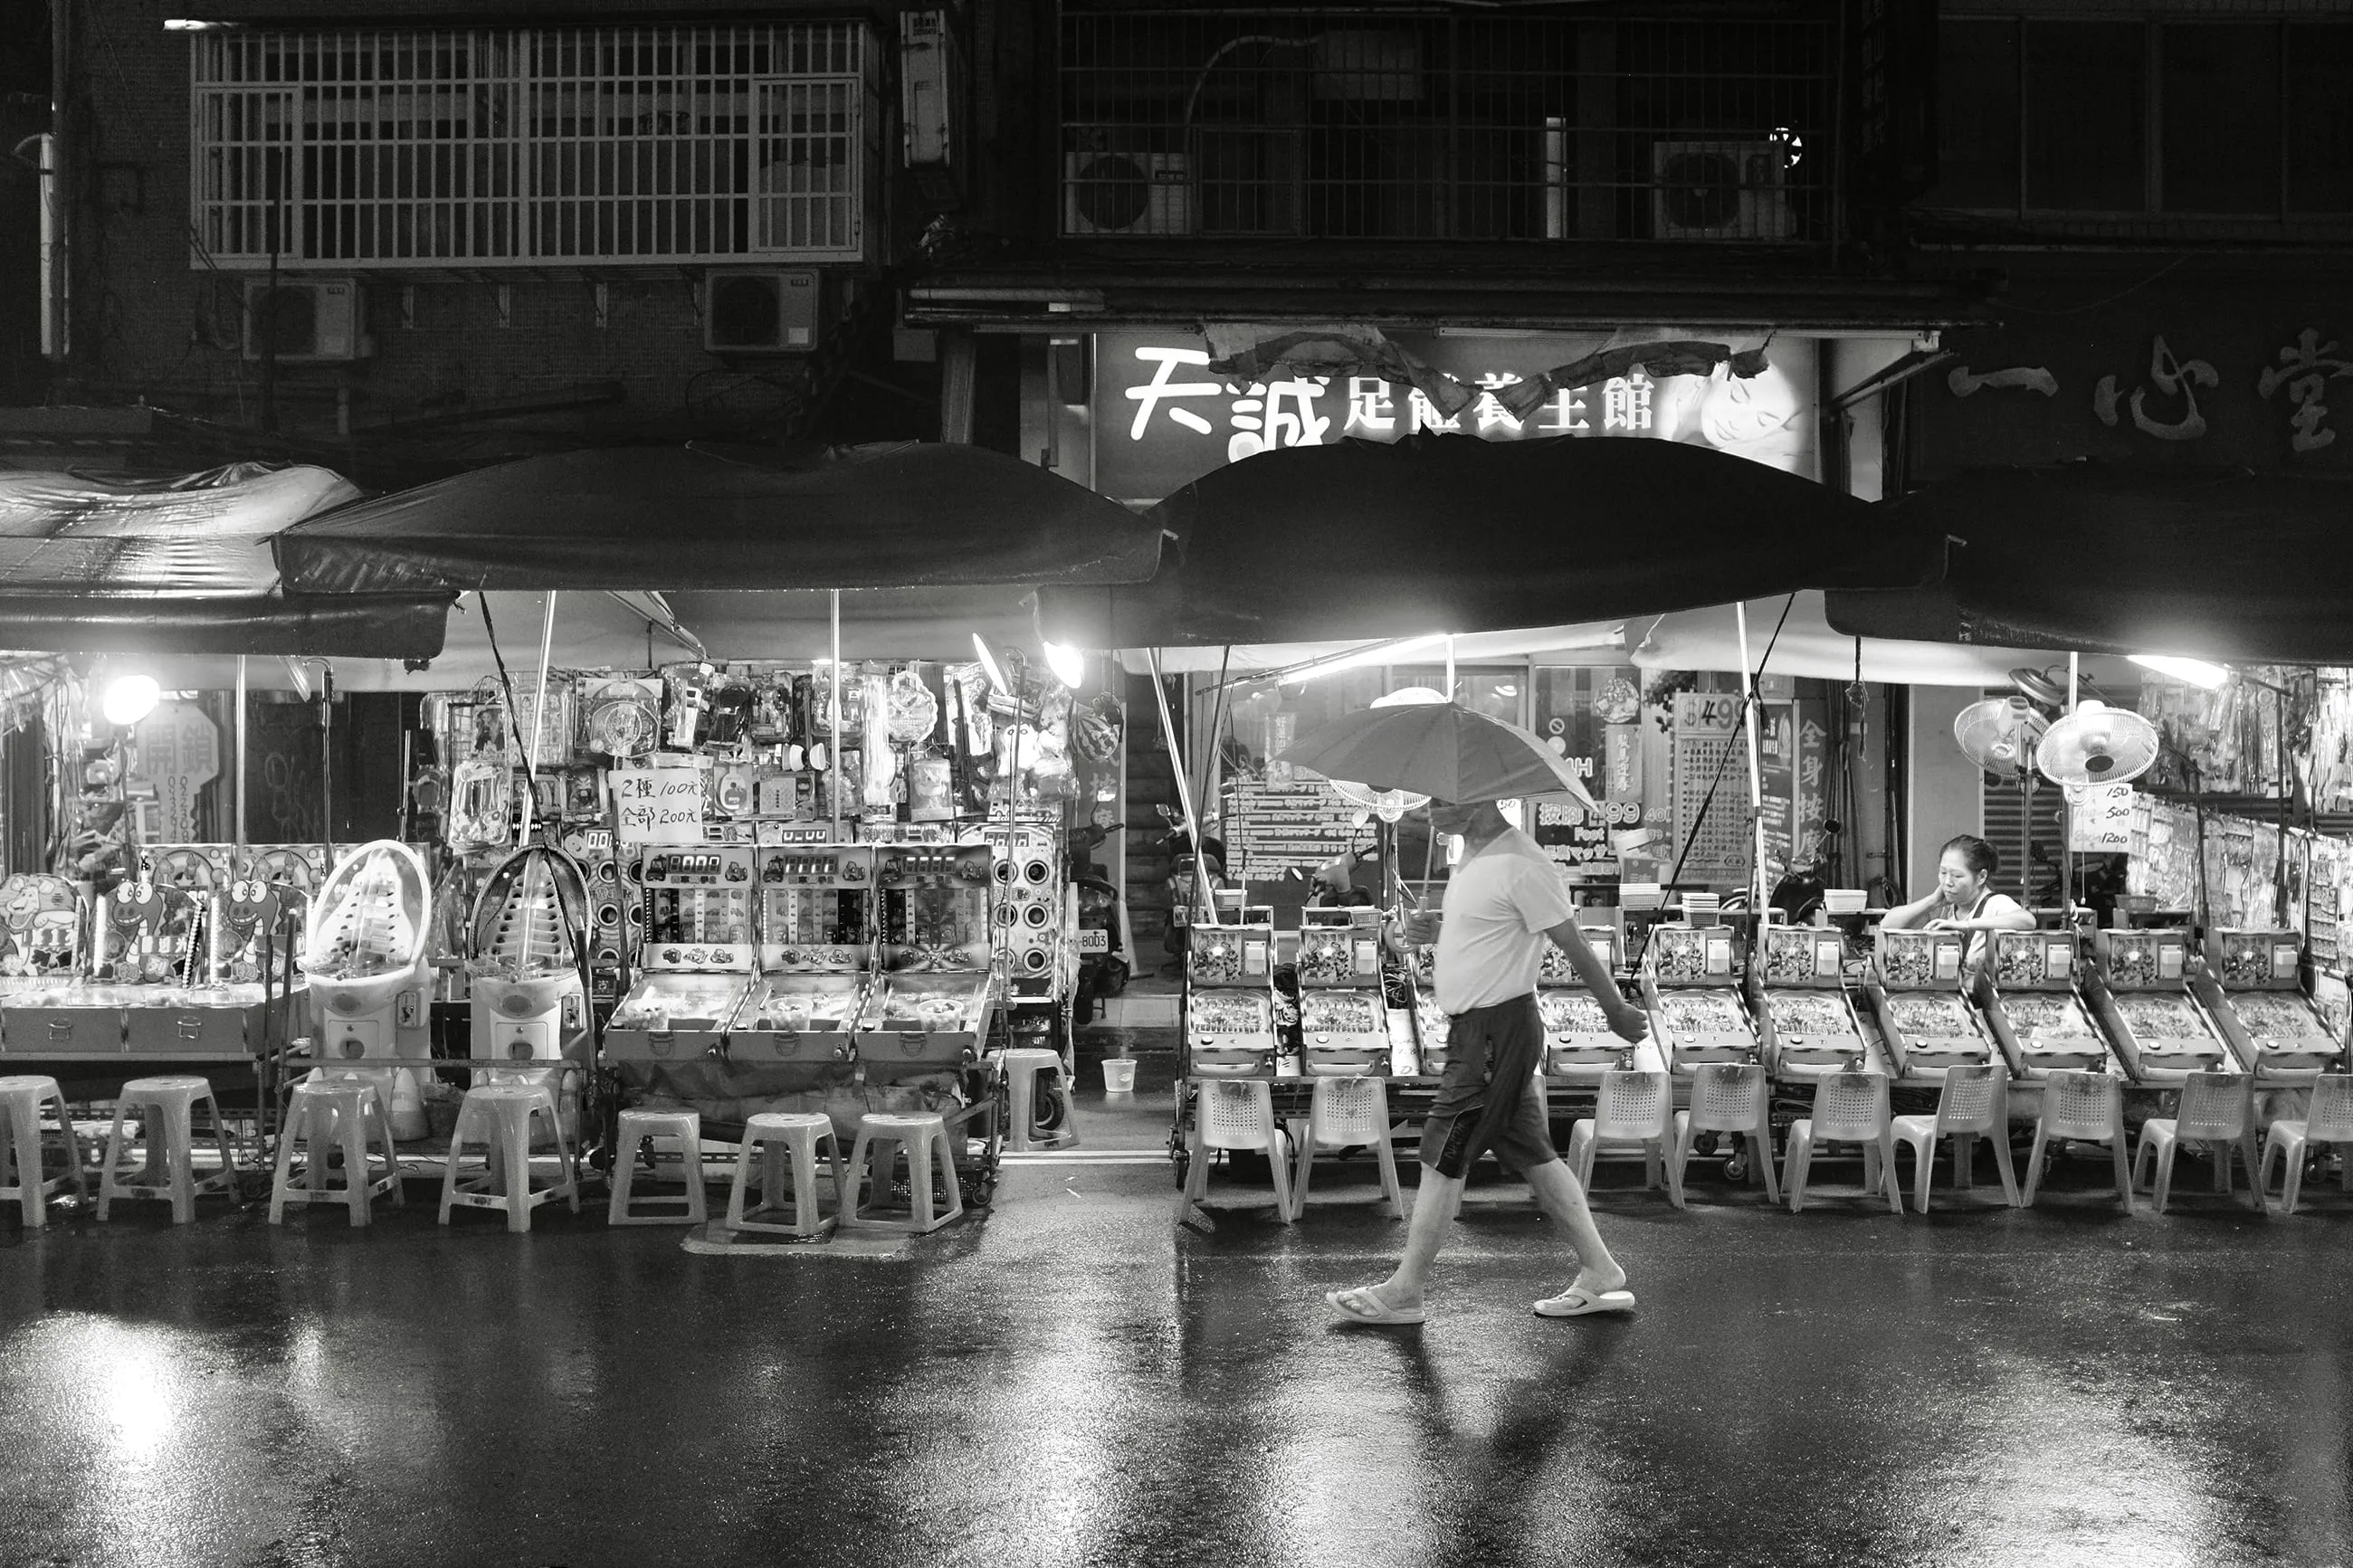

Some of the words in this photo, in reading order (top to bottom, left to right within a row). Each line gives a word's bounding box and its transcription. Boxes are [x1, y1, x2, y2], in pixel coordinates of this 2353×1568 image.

[1948, 328, 2353, 451] 一心堂
[1126, 347, 1329, 460] 天誠
[145, 723, 214, 774] 開鎖
[2107, 786, 2129, 798] 150
[621, 804, 655, 832] 全部
[2106, 805, 2129, 819] 500
[1575, 827, 1605, 841] Foot
[2101, 832, 2128, 843] 1200
